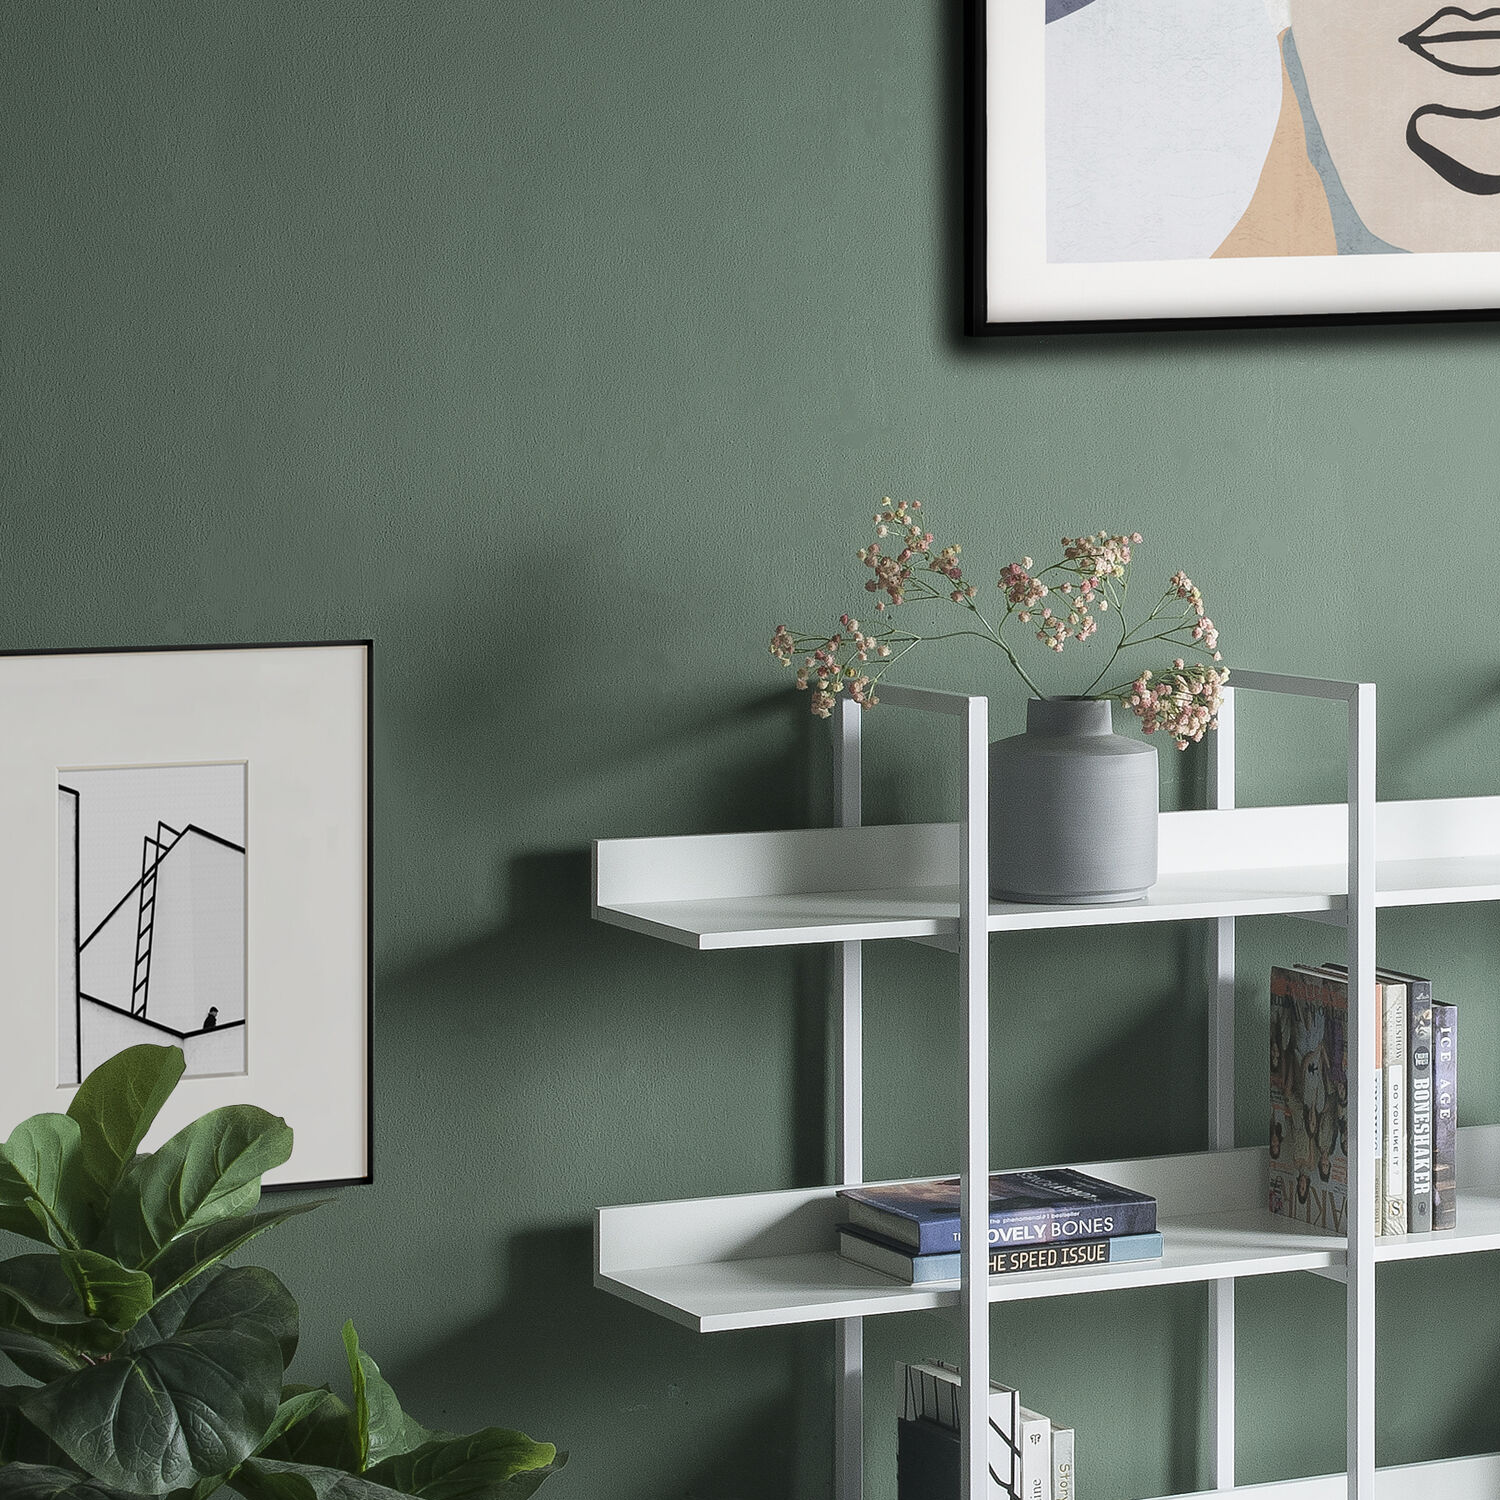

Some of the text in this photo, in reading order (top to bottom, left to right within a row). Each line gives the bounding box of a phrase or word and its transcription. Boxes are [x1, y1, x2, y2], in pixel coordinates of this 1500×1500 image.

[1439, 1026, 1451, 1120] ICE AGE
[1393, 1084, 1399, 1098] DO
[1413, 1077, 1430, 1195] BONESHAKER
[1393, 1155, 1399, 1167] IT
[988, 1217, 1114, 1243] OVELY BONES
[988, 1244, 1106, 1272] HE SPEED ISSUE
